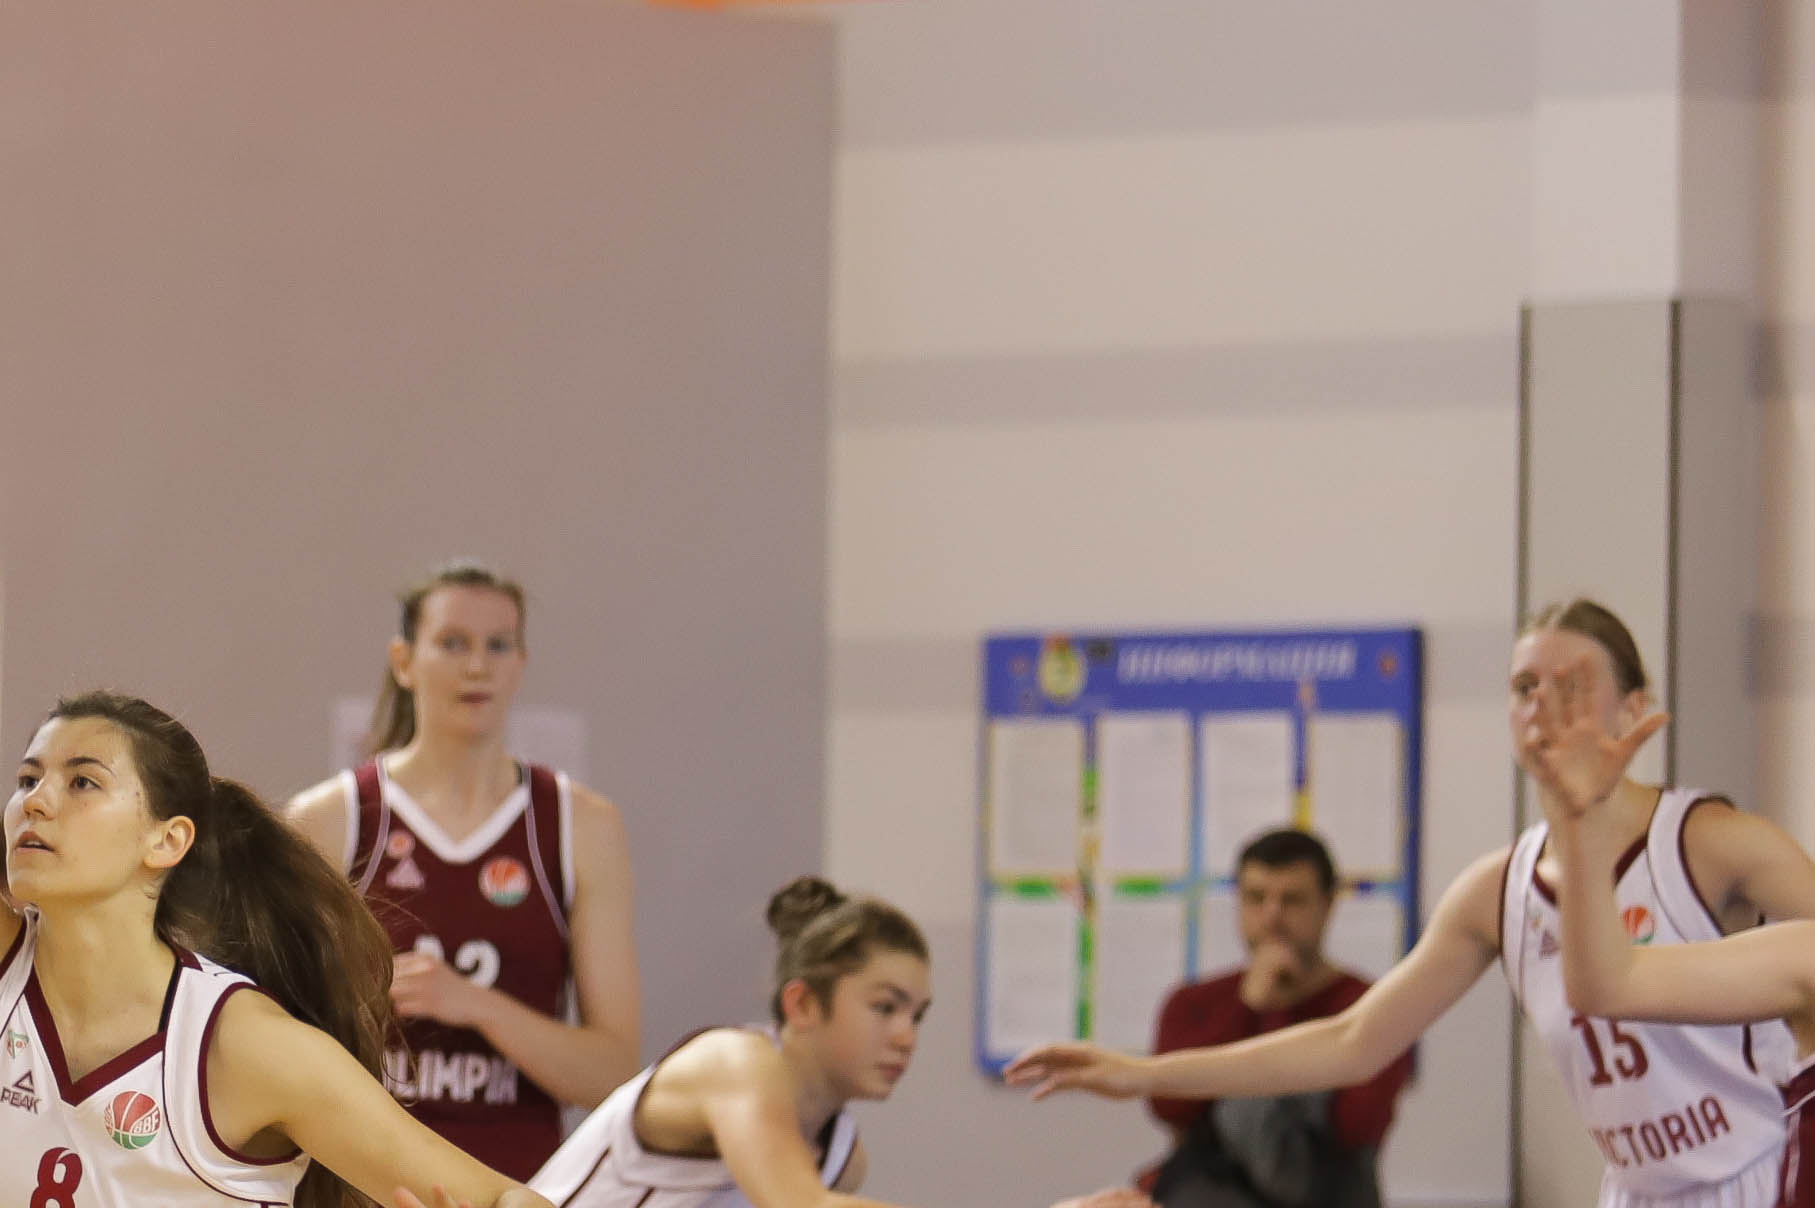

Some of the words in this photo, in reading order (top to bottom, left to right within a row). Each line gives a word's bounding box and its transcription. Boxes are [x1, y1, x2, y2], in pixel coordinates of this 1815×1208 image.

[1571, 1016, 1649, 1085] 15
[0, 1087, 42, 1115] PEAK
[133, 1110, 160, 1134] BBF
